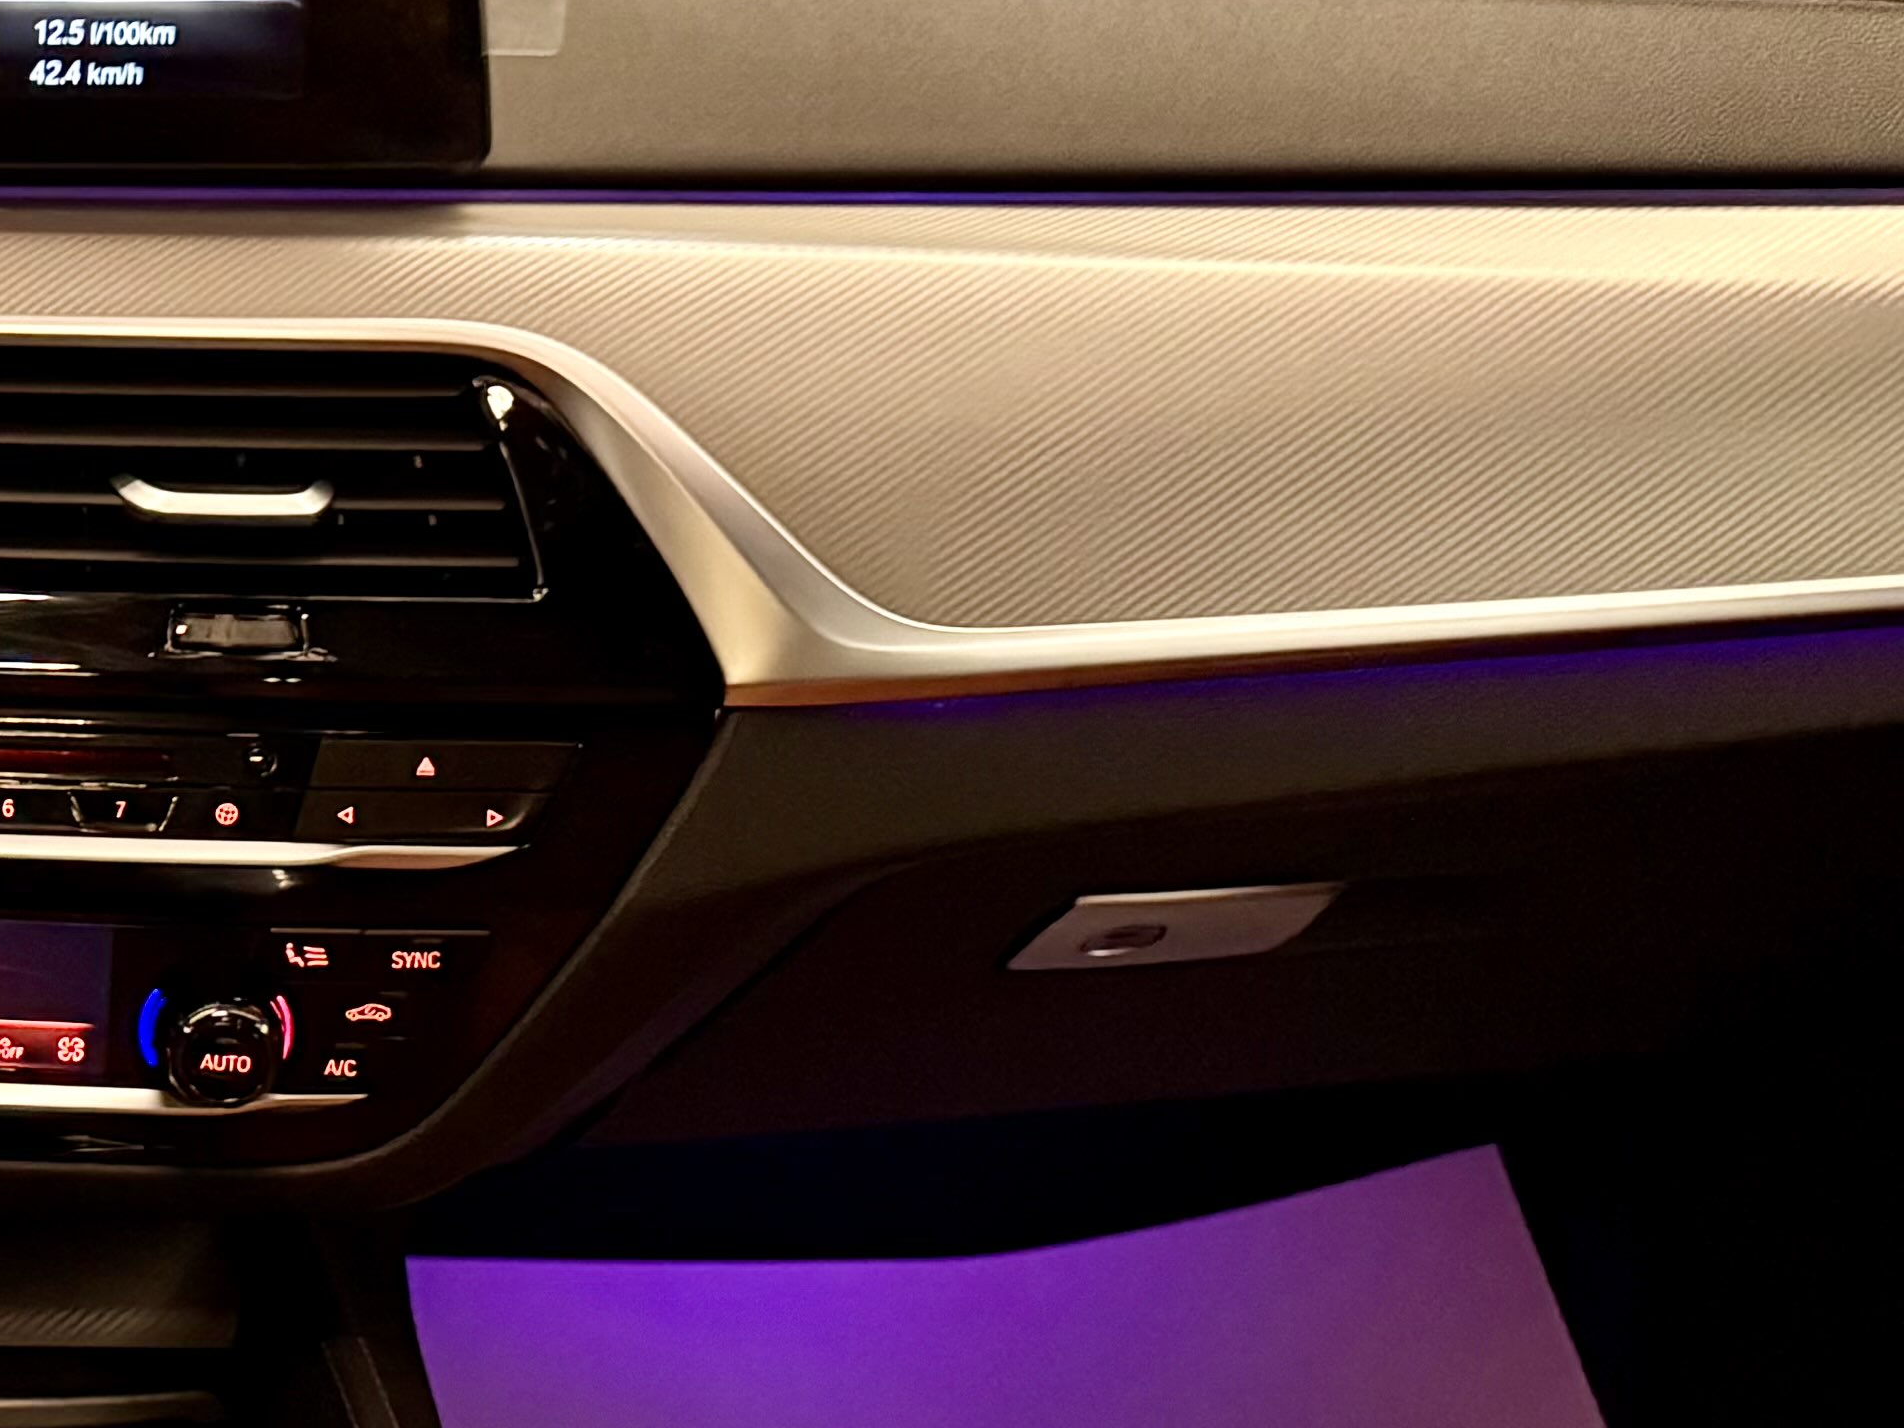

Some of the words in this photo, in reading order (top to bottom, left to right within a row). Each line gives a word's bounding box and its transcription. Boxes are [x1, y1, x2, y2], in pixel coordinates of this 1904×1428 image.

[34, 19, 86, 46] 12.5
[29, 60, 81, 86] 42.4
[2, 799, 15, 819] 6
[115, 800, 126, 819] 7
[391, 950, 441, 971] SYNC
[199, 1053, 252, 1075] AUTO
[324, 1058, 357, 1079] A/C
